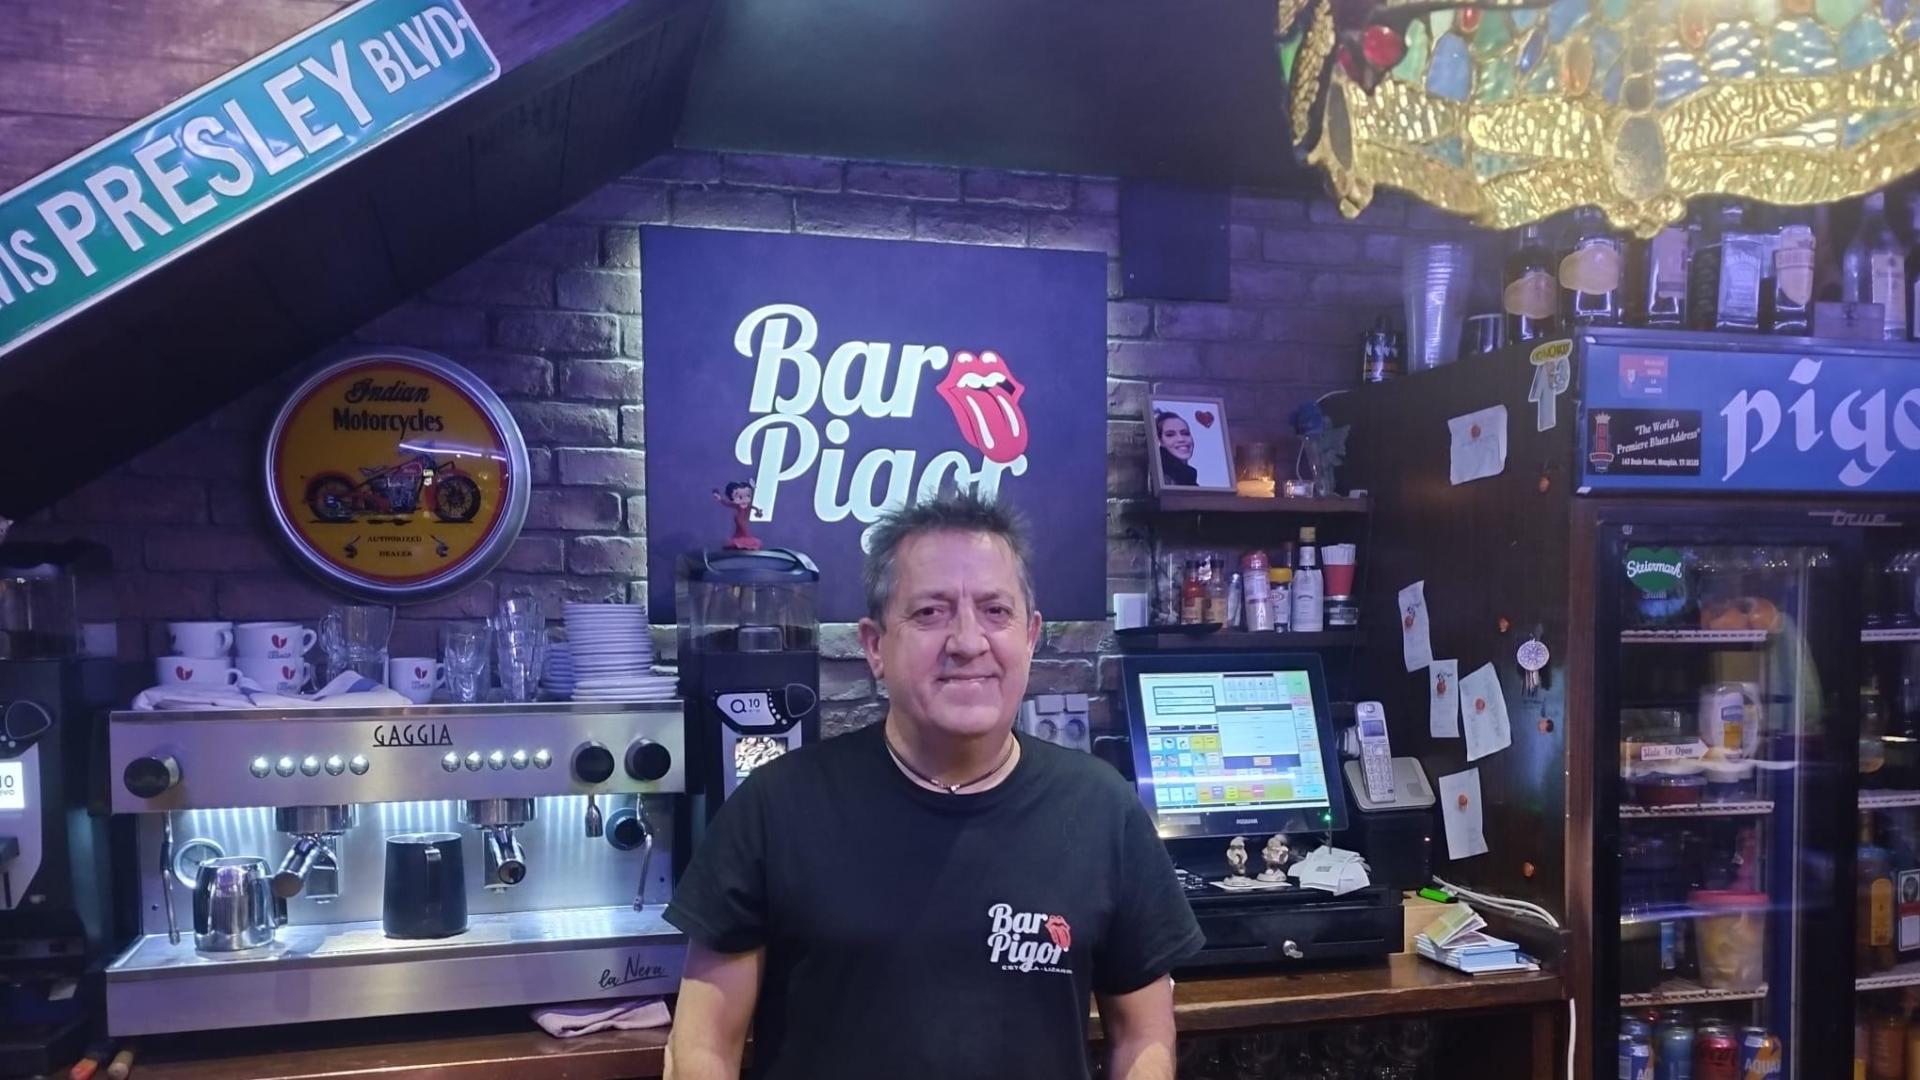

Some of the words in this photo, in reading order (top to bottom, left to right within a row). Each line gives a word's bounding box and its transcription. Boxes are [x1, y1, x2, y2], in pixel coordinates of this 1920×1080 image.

[37, 39, 373, 277] PRESLEY
[734, 303, 949, 418] Bar
[344, 377, 431, 404] Indian
[332, 407, 444, 440] Motorcycles
[1652, 418, 1680, 432] World's
[1617, 440, 1649, 455] Premiere
[1649, 436, 1669, 448] Blues
[1626, 560, 1682, 578] Steiermark
[373, 723, 453, 747] GAGGIA
[987, 903, 1049, 934] Bar
[622, 952, 669, 983] Nera
[987, 932, 1070, 972] Pigor
